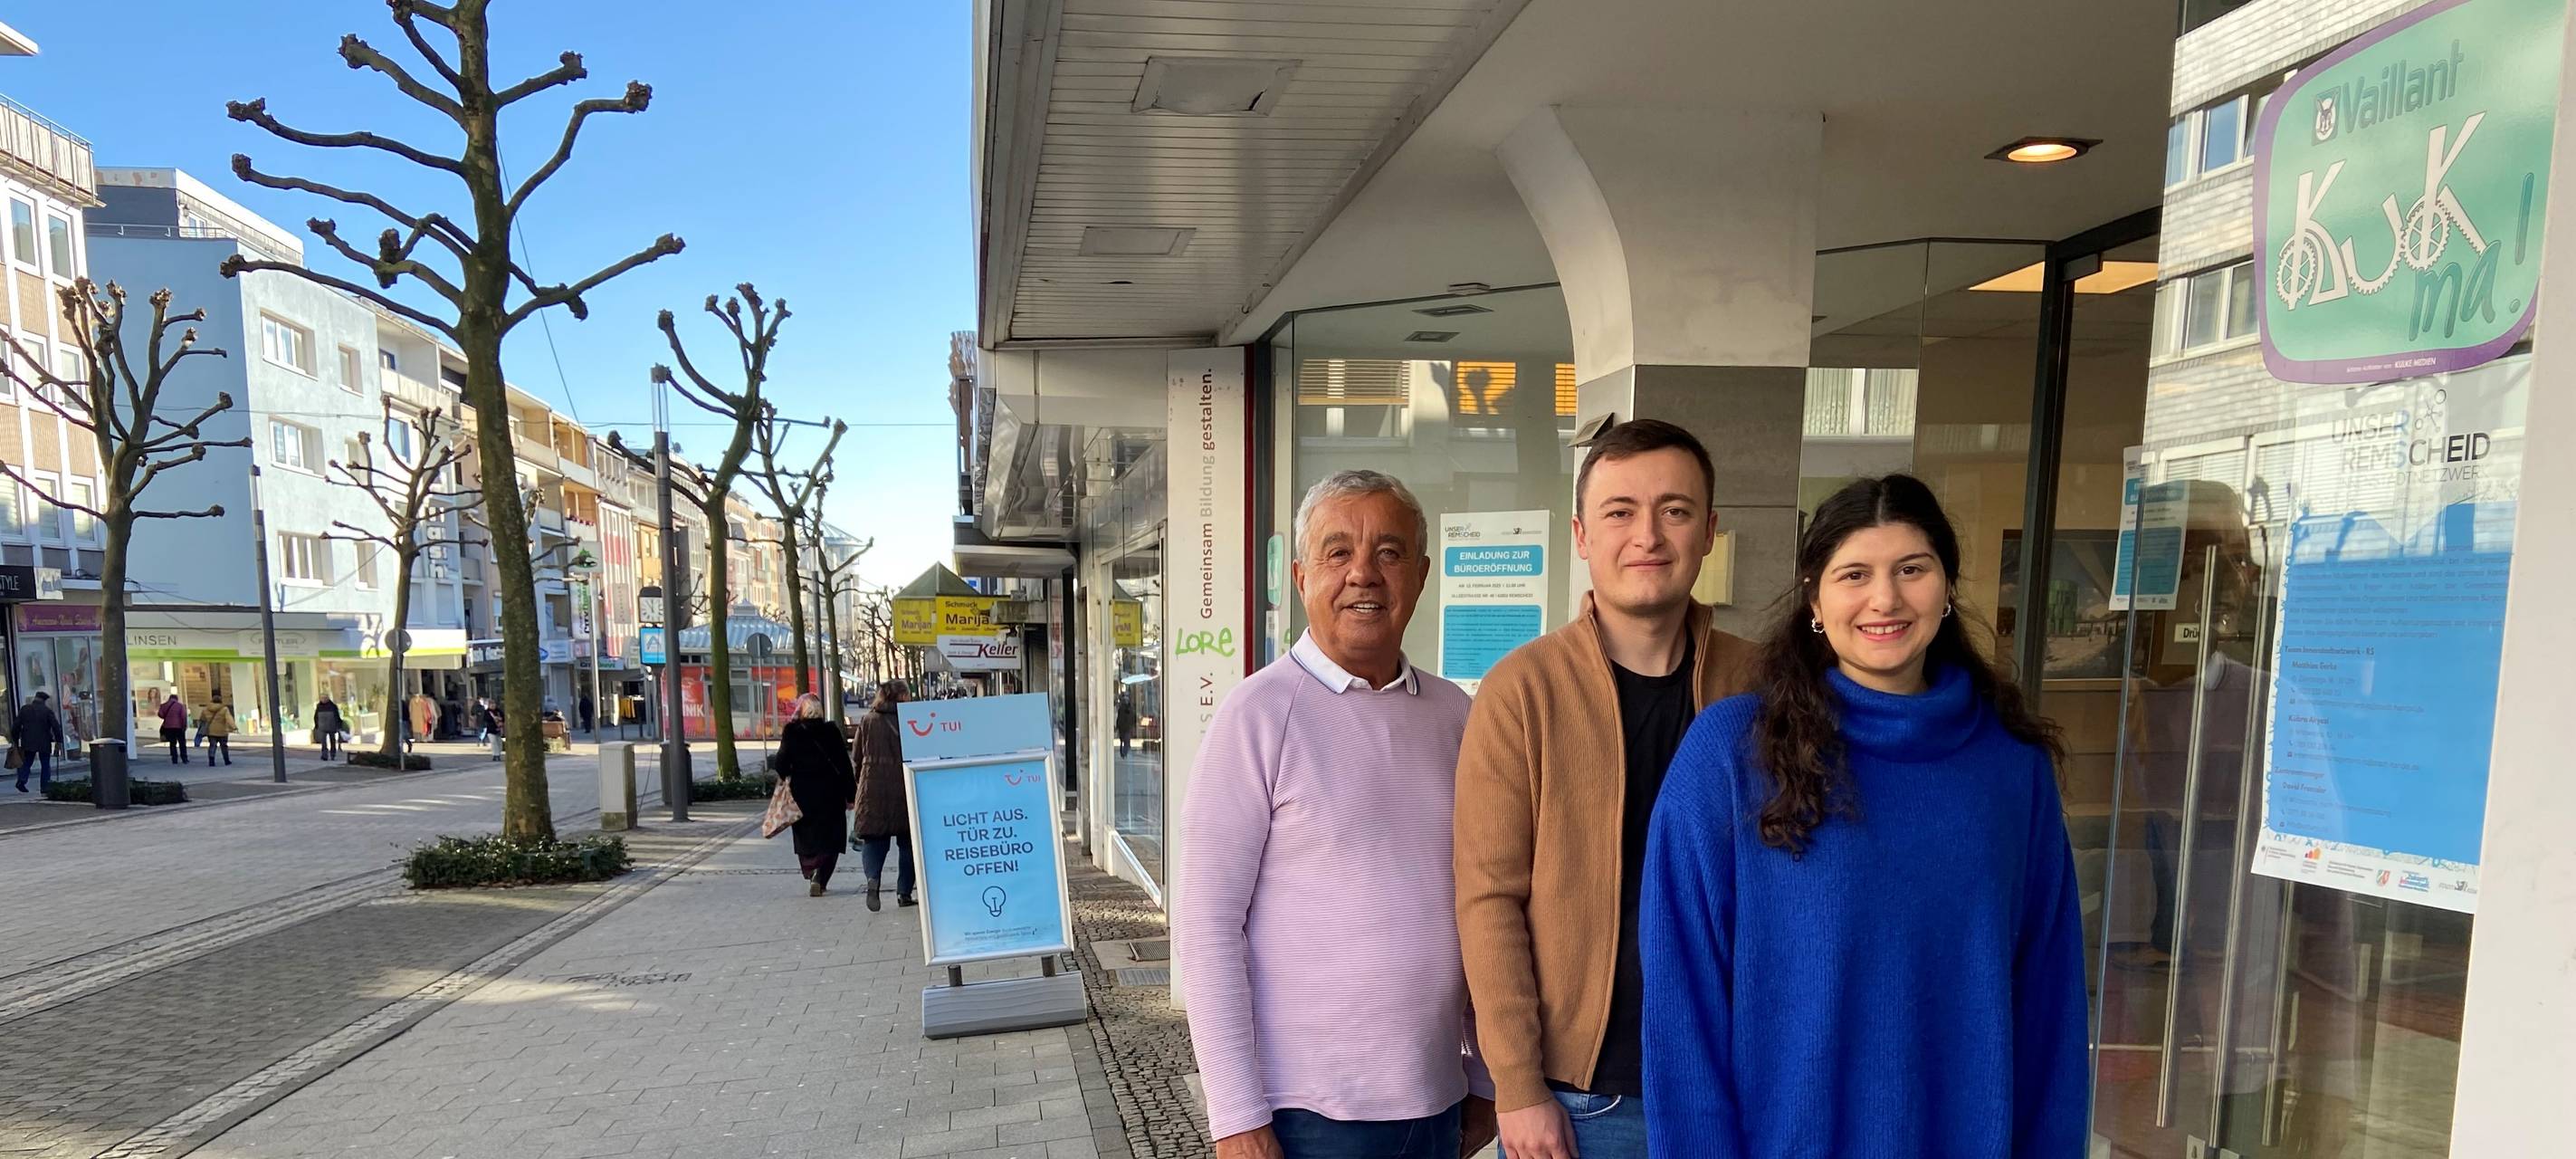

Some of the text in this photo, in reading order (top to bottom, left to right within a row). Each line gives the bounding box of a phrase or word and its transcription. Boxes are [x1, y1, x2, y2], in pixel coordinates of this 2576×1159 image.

[2334, 39, 2465, 133] Vaillant
[2331, 410, 2410, 444] UNSER
[2342, 433, 2491, 474] REMSCHEID
[1199, 368, 1216, 620] Gemeinsam Bildung gestalten.
[1459, 550, 1530, 560] EINLADUNG ZUR
[1454, 562, 1533, 573] BÜROERÖFFNUNG
[945, 600, 978, 608] Schmuck
[946, 613, 990, 627] Marija
[978, 643, 1018, 658] Keller
[1200, 672, 1213, 706] E.V.
[940, 721, 962, 733] TUI
[1027, 774, 1041, 783] TUI
[943, 808, 1028, 828] LICHT AUS.
[958, 826, 1017, 843] TÜR ZU.
[945, 841, 1034, 862] REISEBÜRO
[963, 859, 1019, 876] OFFEN!
